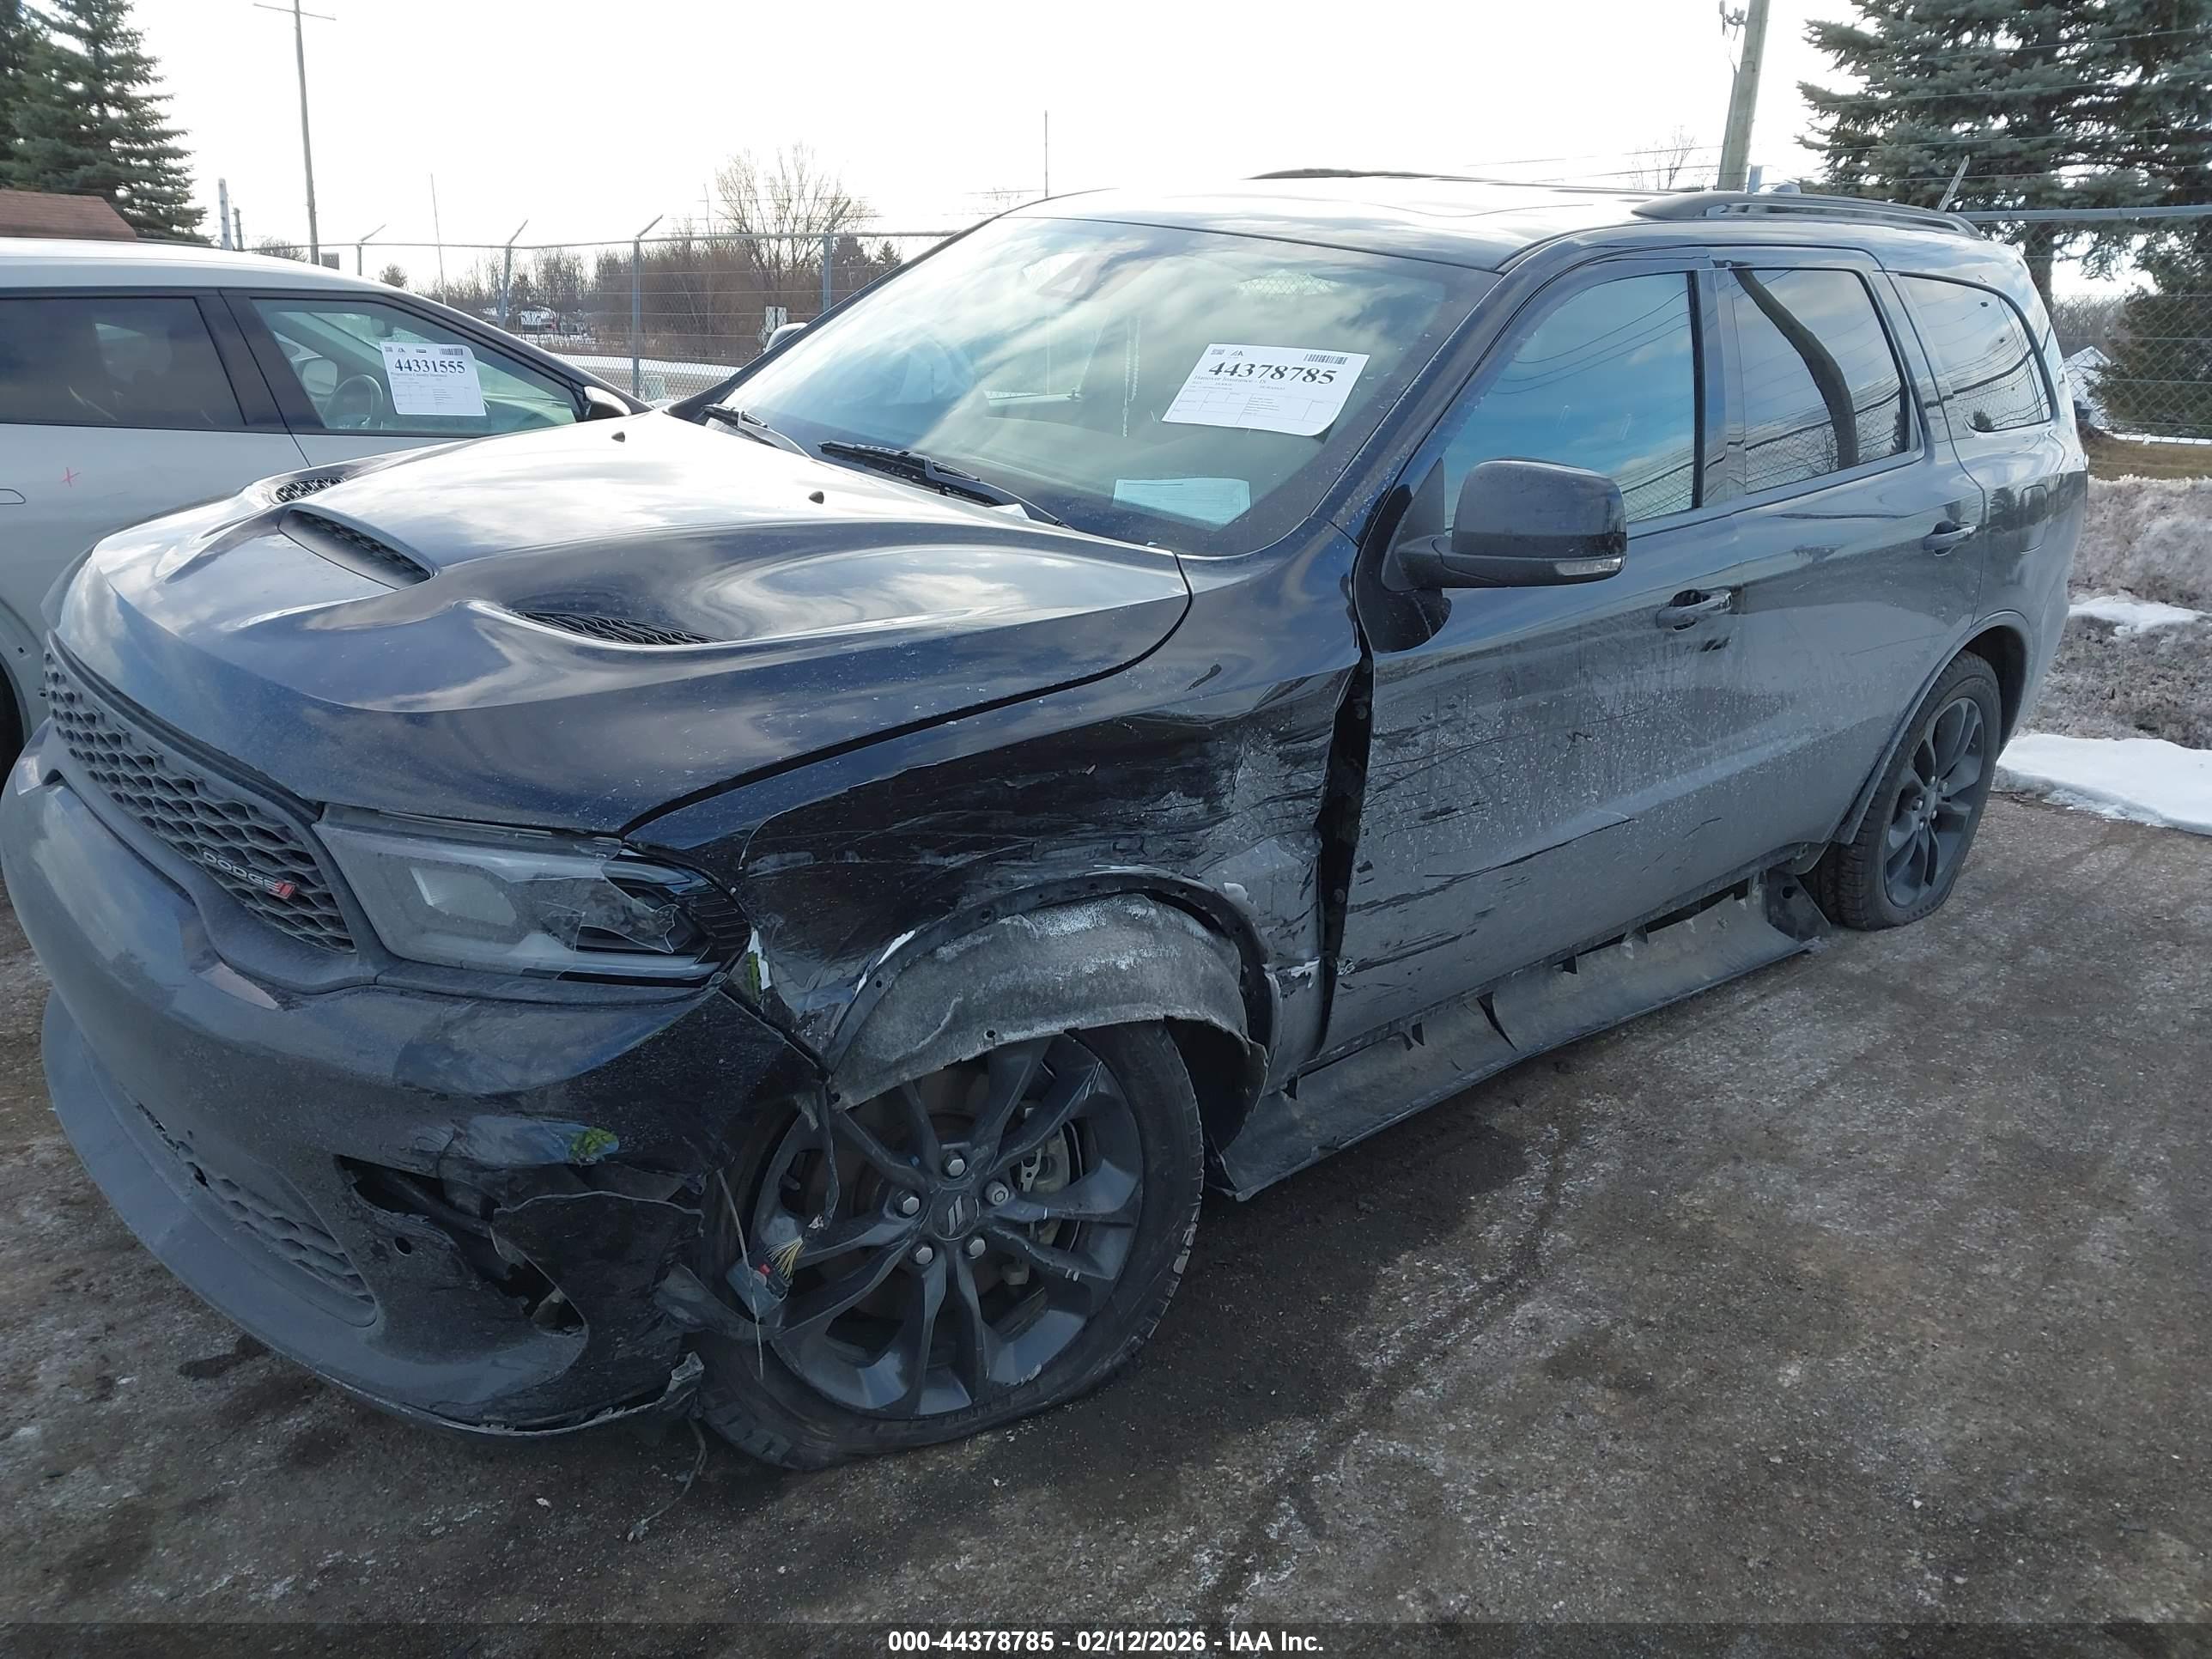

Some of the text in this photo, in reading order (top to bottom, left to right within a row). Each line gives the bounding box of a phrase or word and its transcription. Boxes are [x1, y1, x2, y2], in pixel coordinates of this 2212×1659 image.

[394, 358, 465, 374] 44331555
[1208, 362, 1338, 385] 44378785
[204, 851, 281, 892] DODGE
